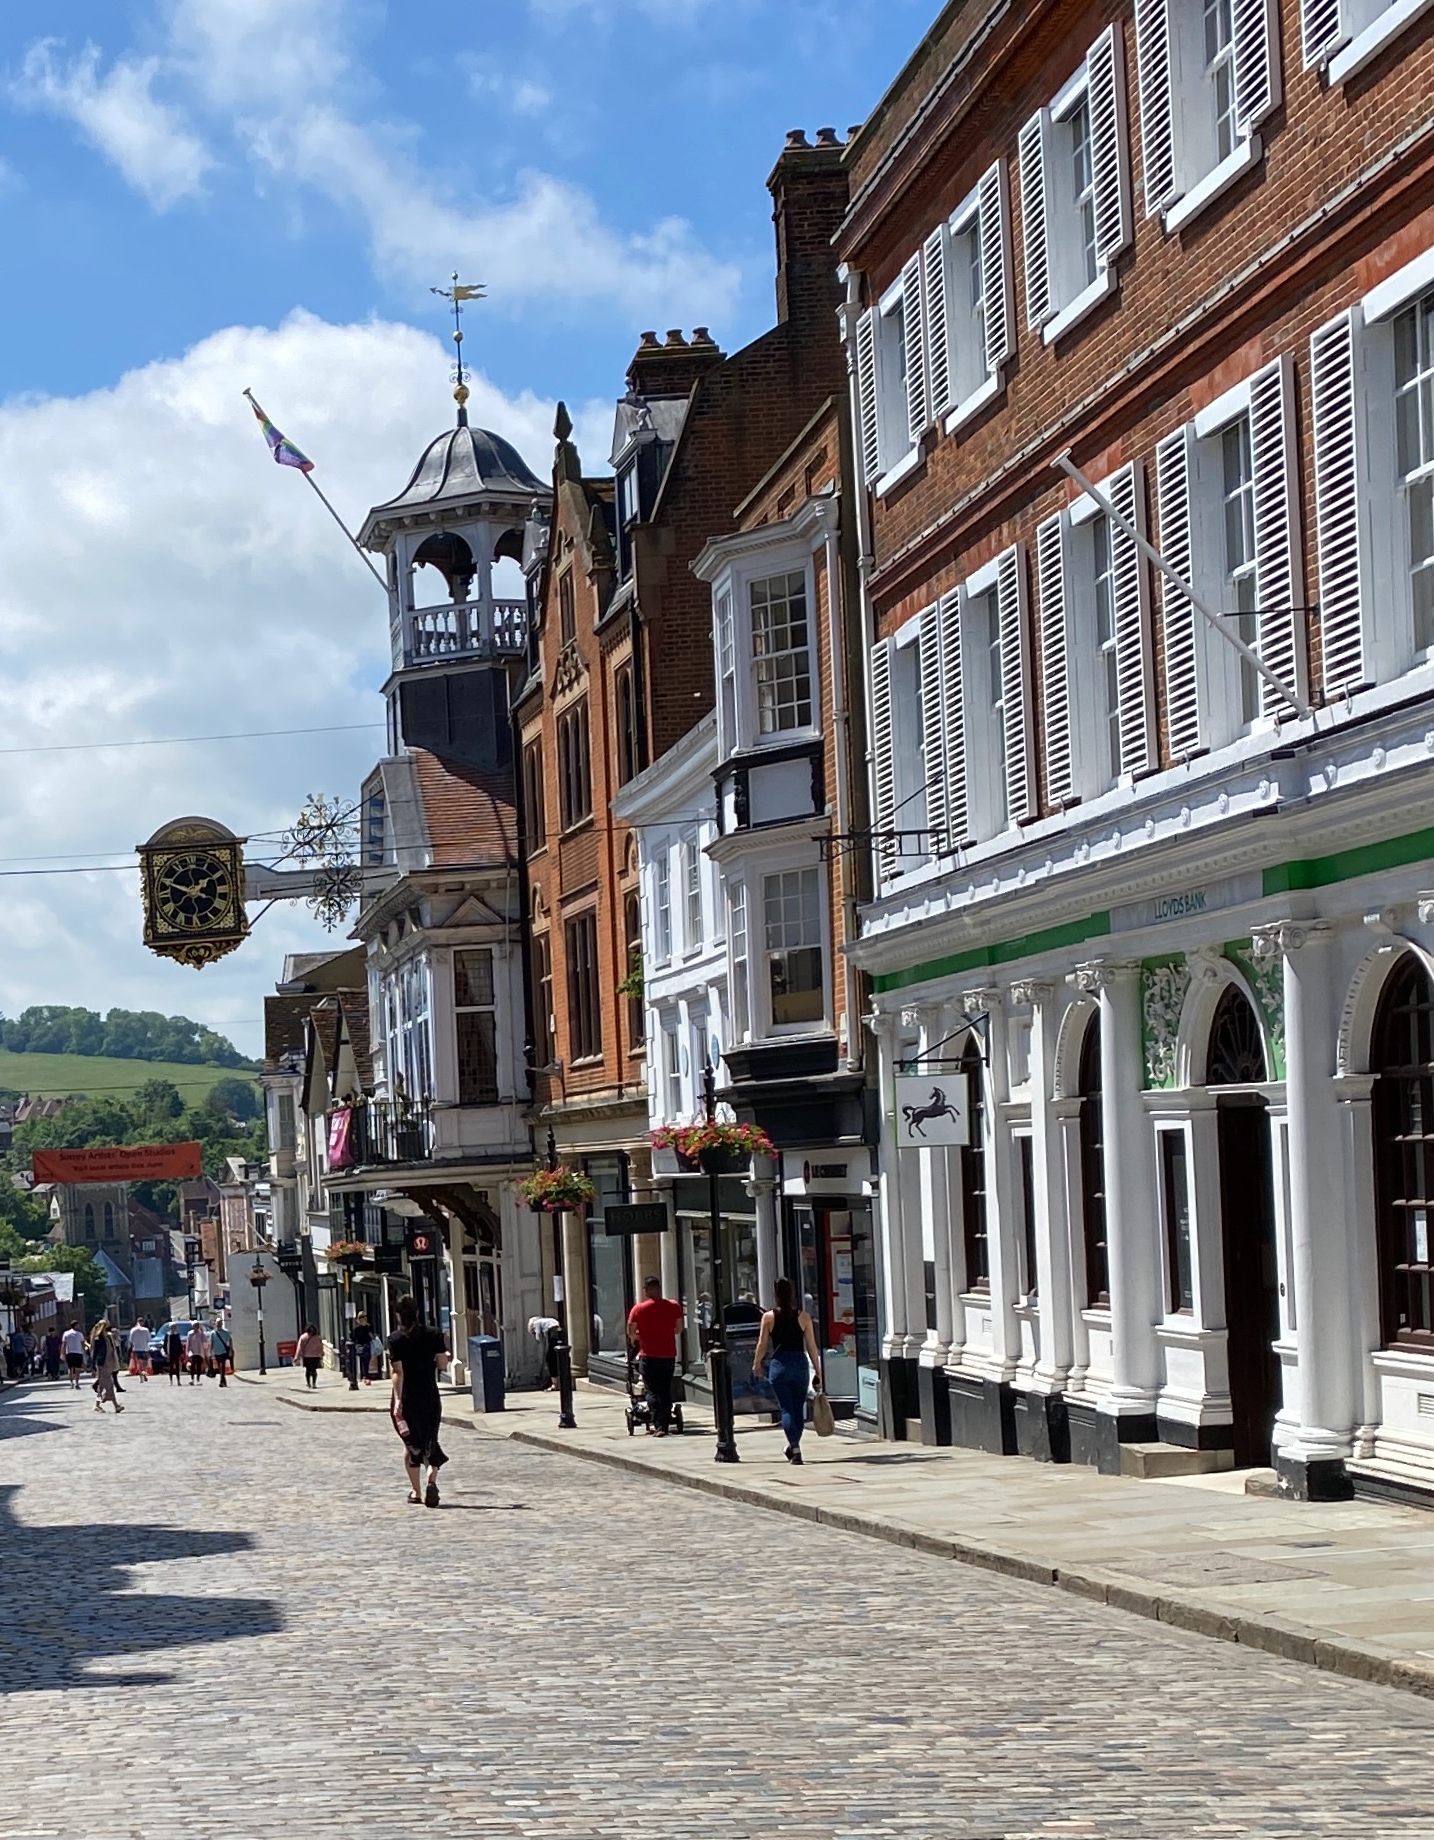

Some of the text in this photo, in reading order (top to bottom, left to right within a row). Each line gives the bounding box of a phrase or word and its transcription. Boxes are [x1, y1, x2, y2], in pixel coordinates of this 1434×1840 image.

[1154, 890, 1207, 919] LLOYDS BANK
[119, 1150, 143, 1159] Open
[144, 1148, 176, 1157] Studios
